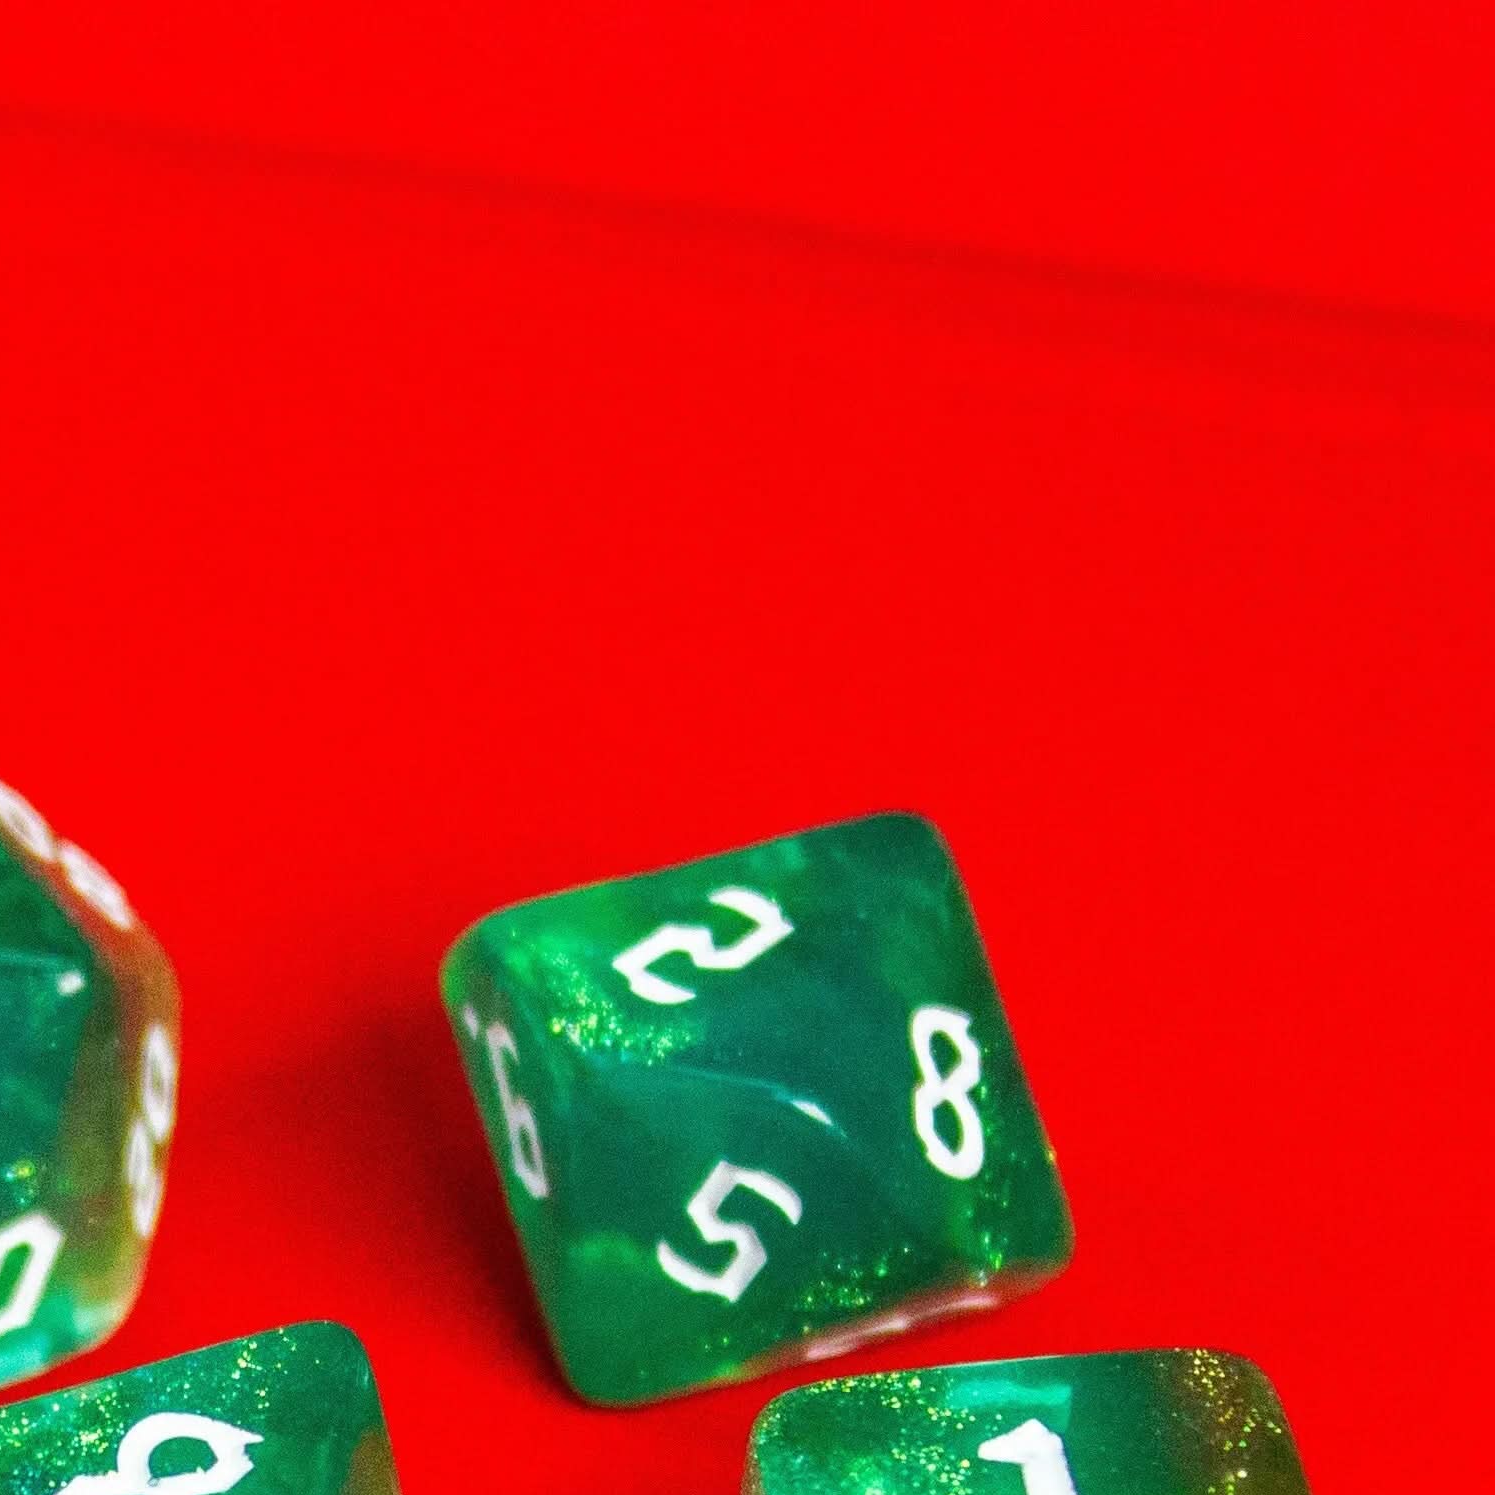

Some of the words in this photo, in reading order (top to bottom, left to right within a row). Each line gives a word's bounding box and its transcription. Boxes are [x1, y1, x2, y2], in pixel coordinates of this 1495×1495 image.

[611, 885, 795, 1005] 2
[910, 1005, 986, 1181] 8
[656, 1160, 803, 1303] 5
